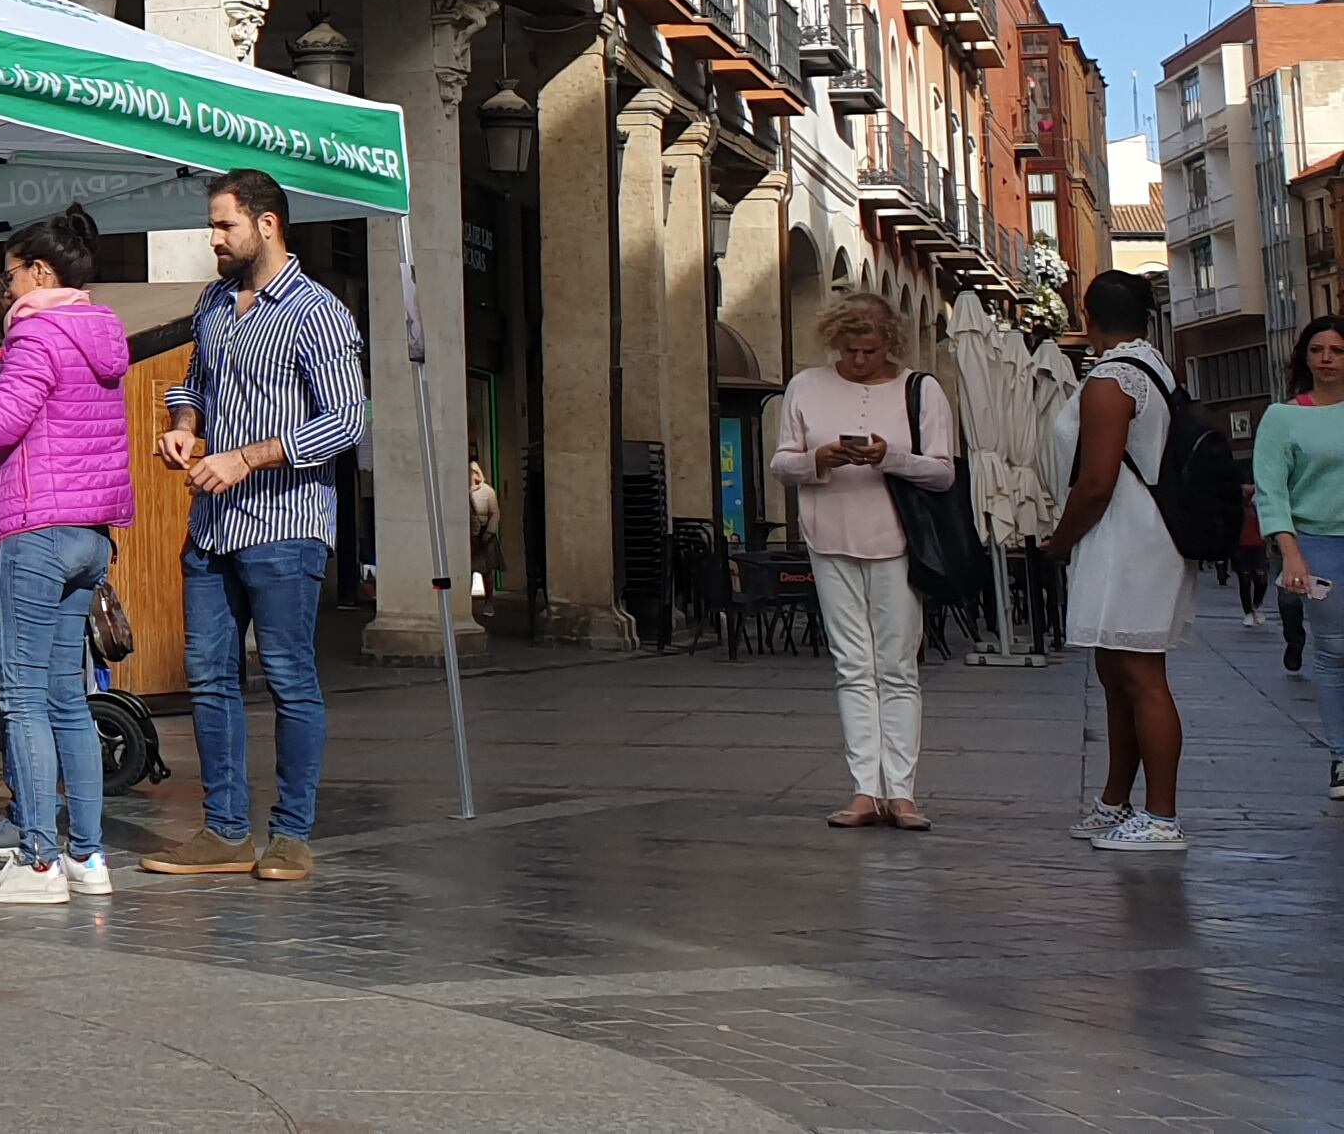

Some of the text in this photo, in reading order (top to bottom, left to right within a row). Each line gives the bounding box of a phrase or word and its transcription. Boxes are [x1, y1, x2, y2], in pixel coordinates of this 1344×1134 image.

[62, 73, 193, 130] ESPAÑOLA
[196, 102, 287, 156] CONTRA
[288, 128, 318, 161] EL
[319, 132, 402, 180] CÁNCER
